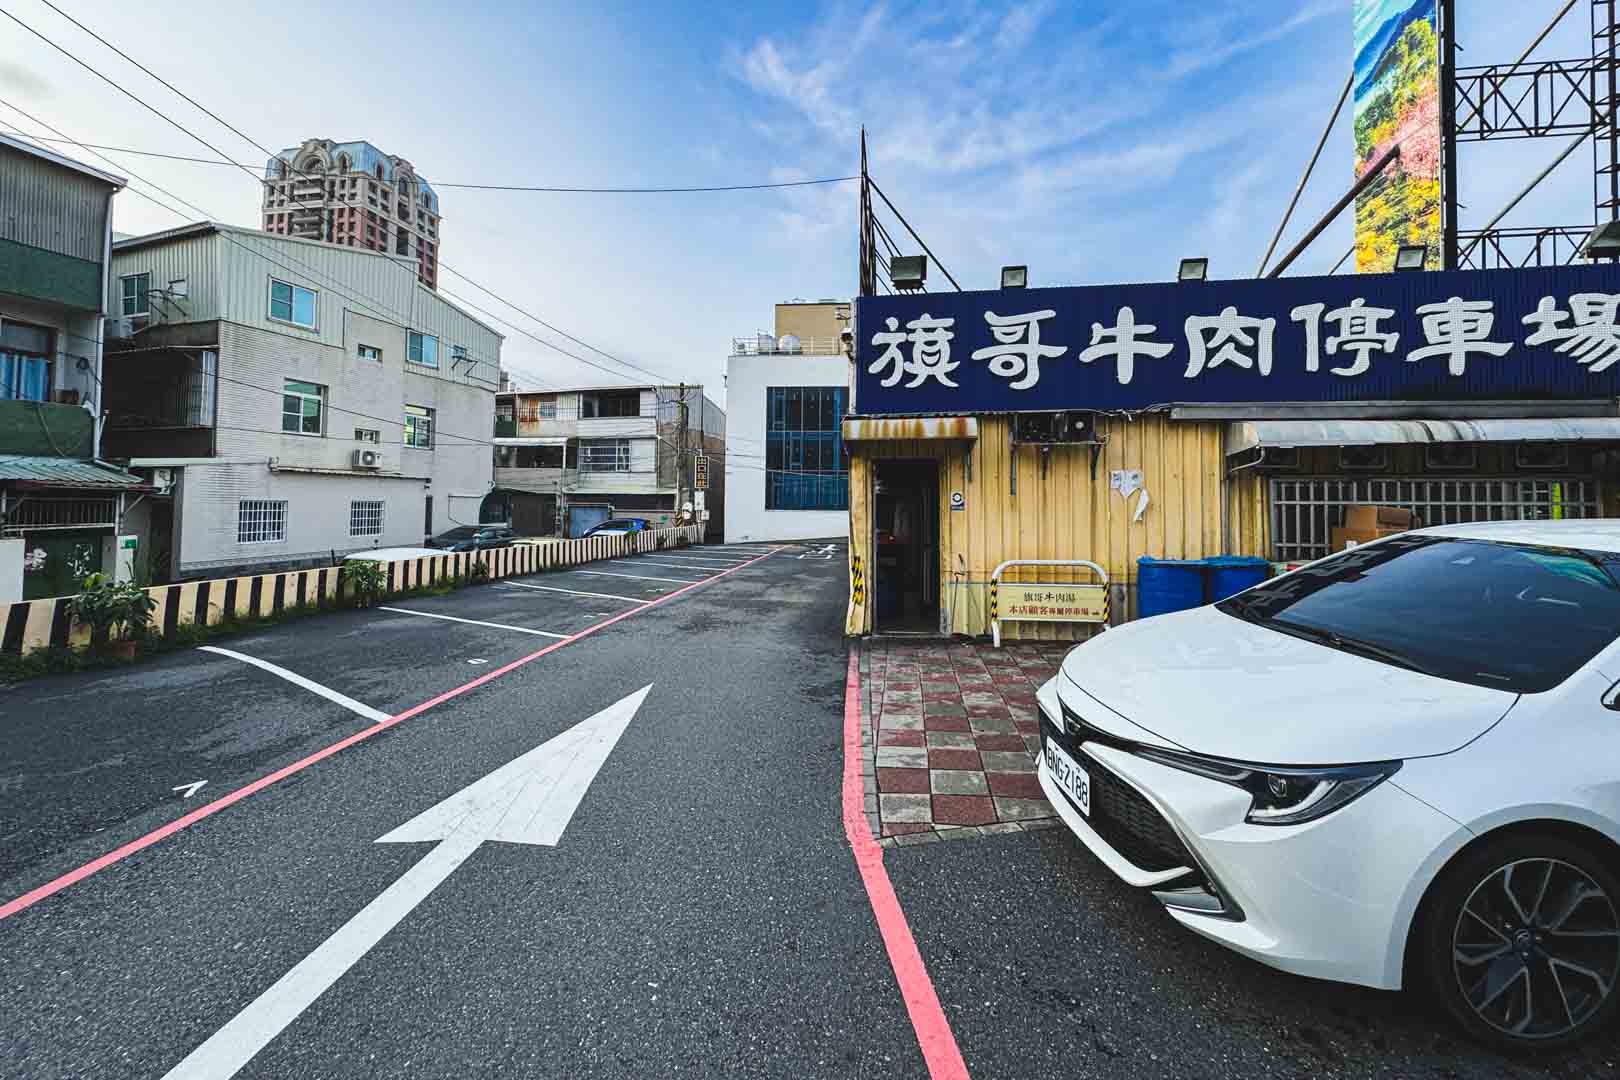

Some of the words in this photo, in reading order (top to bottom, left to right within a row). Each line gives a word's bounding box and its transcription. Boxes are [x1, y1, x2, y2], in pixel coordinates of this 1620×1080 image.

[867, 293, 1620, 390] 旗哥牛肉停車場
[1047, 745, 1088, 807] BNG-2188
